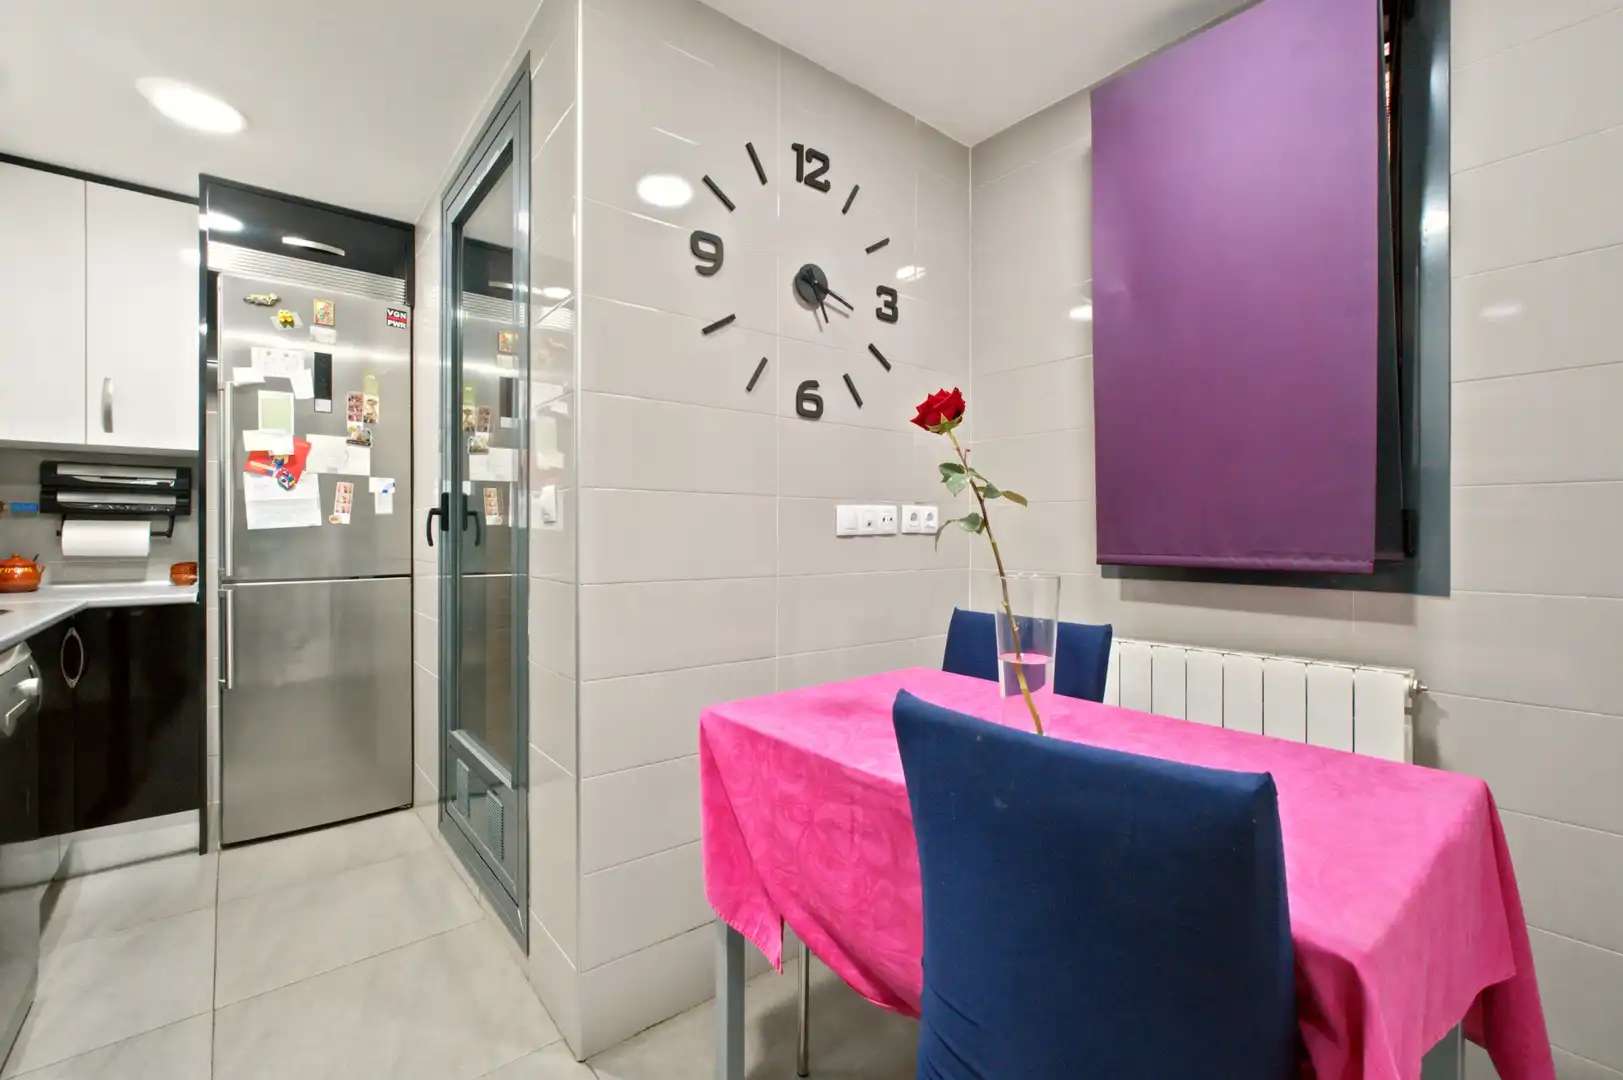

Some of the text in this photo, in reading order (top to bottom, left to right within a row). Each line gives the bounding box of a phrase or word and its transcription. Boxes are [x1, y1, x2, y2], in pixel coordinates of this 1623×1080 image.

[791, 142, 831, 193] 12
[690, 230, 724, 276] 9
[387, 309, 407, 319] VGN
[876, 285, 898, 323] 3
[387, 319, 406, 329] PWR
[796, 380, 824, 419] 6
